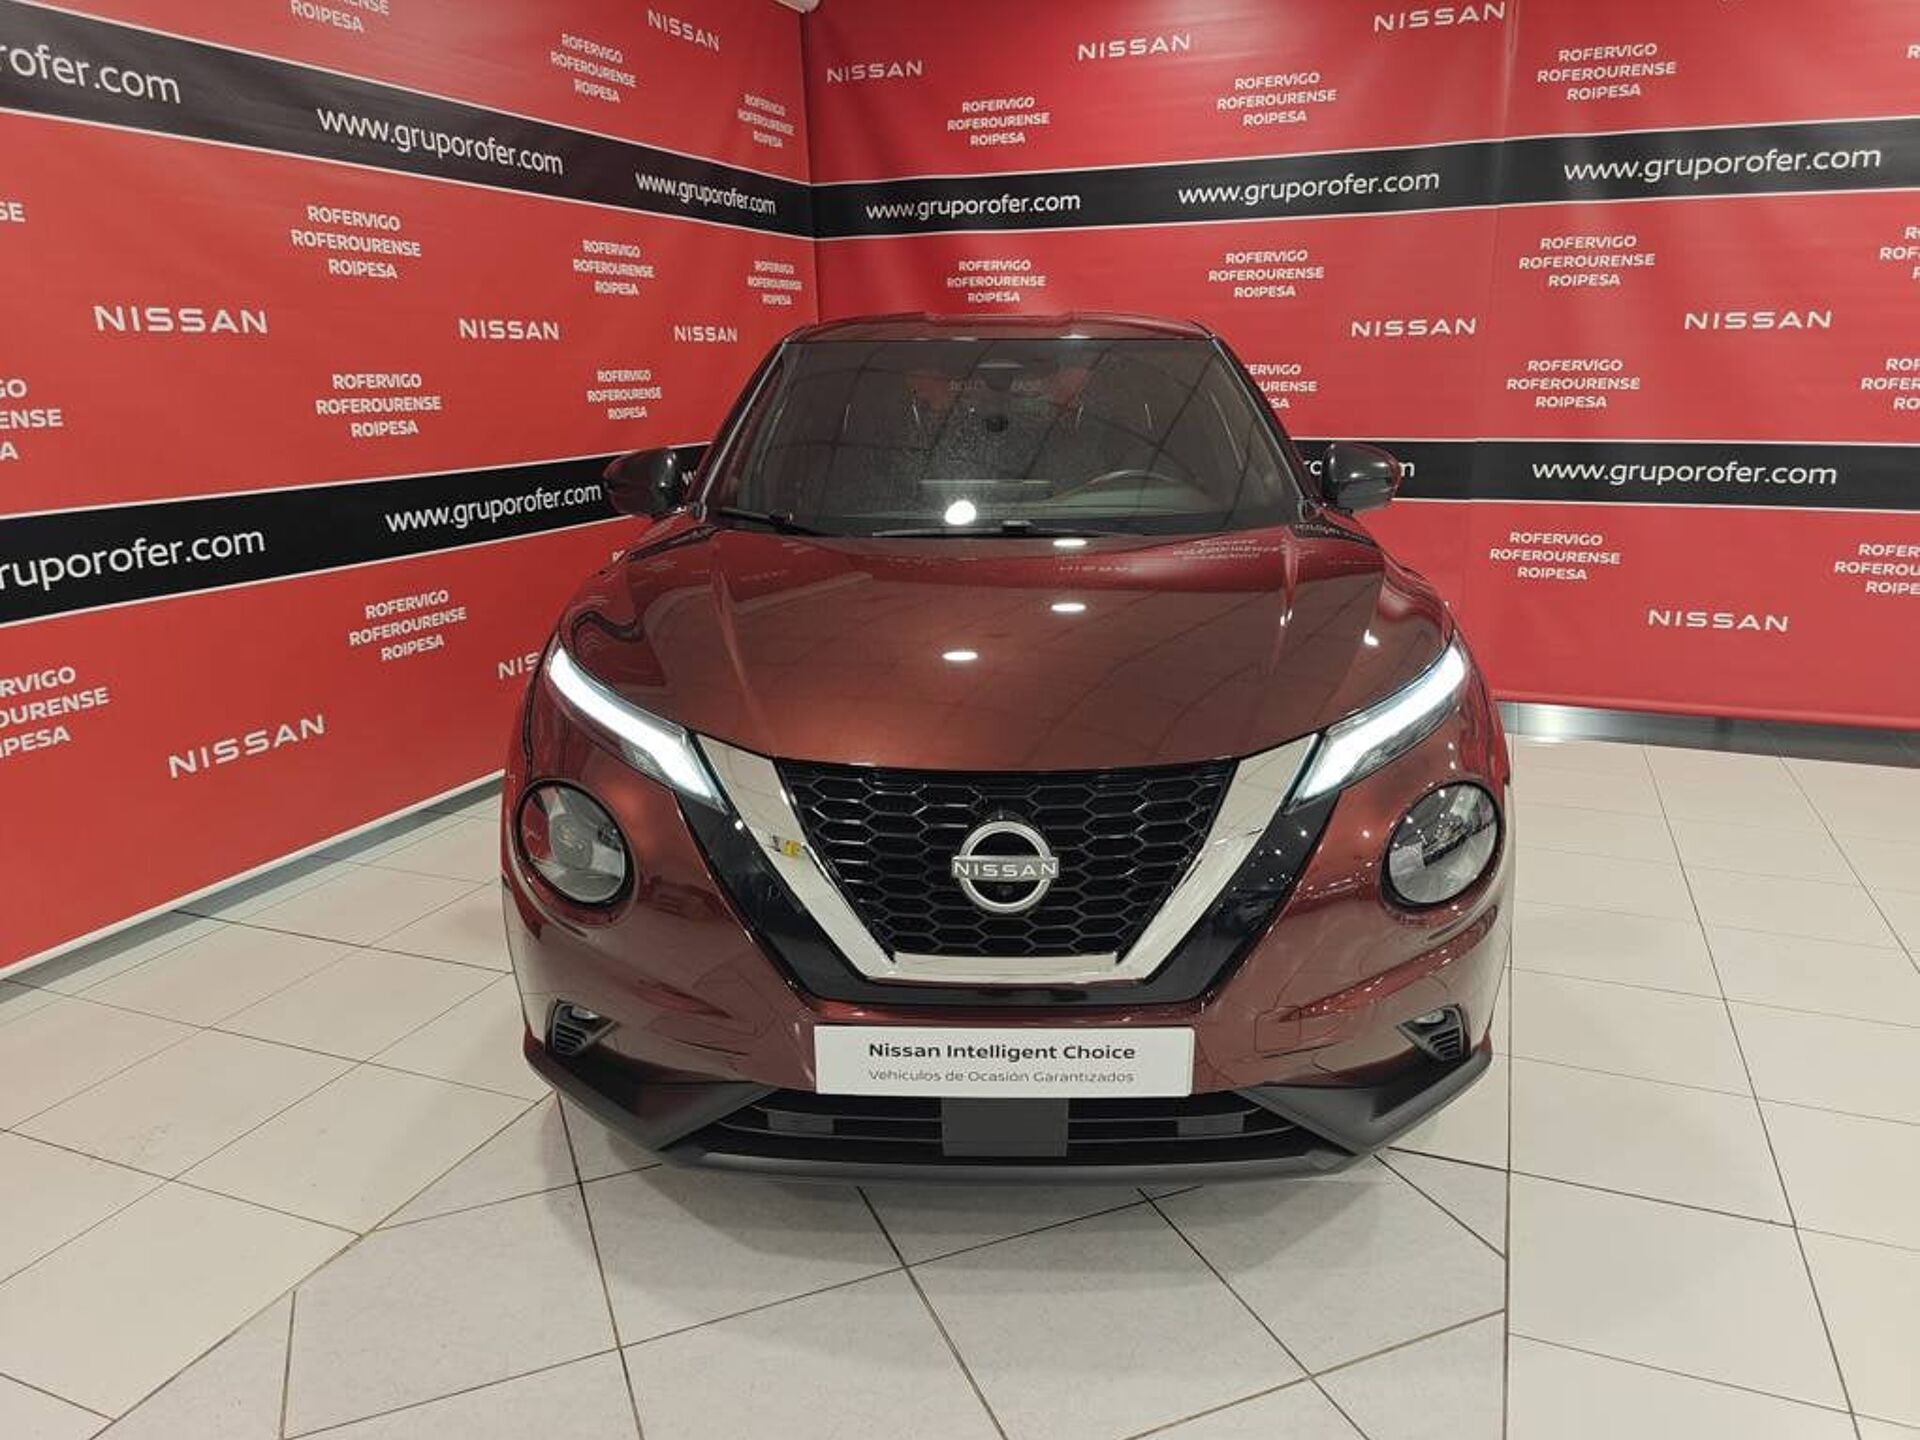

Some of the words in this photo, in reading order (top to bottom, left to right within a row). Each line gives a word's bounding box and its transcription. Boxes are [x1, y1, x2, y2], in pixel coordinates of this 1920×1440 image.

[1373, 3, 1505, 32] NISSAN
[647, 9, 720, 52] NISSAN
[562, 33, 623, 64] ROFERVIGO
[1077, 34, 1191, 61] NISSAN
[1558, 43, 1658, 63] ROFERVIGO
[0, 44, 181, 104] ofer.com
[551, 51, 636, 88] ROFEROURENSE
[827, 60, 922, 83] NISSAN
[1537, 62, 1677, 83] ROFEROURENSE
[1234, 72, 1320, 90] ROFERVIGO
[573, 79, 620, 103] ROIPESA
[1217, 89, 1337, 110] ROFEROURENSE
[1567, 84, 1642, 101] ROIPESA
[962, 97, 1035, 114] ROFERVIGO
[947, 112, 1050, 131] ROFEROURENSE
[1242, 110, 1307, 127] ROIPESA
[317, 108, 563, 175] www.gruporofer.com
[970, 132, 1025, 146] ROIPESA
[1564, 148, 1881, 183] www.gruporofer.com
[635, 171, 776, 215] www.gruporofer.com
[1178, 172, 1440, 206] www.gruporofer.com
[866, 191, 1081, 221] www.gruporofer.com
[307, 205, 401, 231] ROFERVIGO
[291, 229, 422, 257] ROFEROURENSE
[583, 240, 641, 259] ROFERVIGO
[1540, 235, 1637, 250] ROFERVIGO
[958, 258, 1032, 272] ROFERVIGO
[1225, 249, 1308, 265] ROFERVIGO
[1519, 253, 1655, 270] ROFEROURENSE
[328, 258, 398, 279] ROIPESA
[1208, 266, 1324, 282] ROFEROURENSE
[947, 275, 1046, 289] ROFEROURENSE
[1548, 273, 1621, 288] ROIPESA
[967, 290, 1021, 303] ROIPESA
[1233, 285, 1297, 299] ROIPESA
[94, 305, 267, 334] NISSAN
[1351, 318, 1477, 337] NISSAN
[1683, 310, 1832, 331] NISSAN
[459, 319, 560, 342] NISSAN
[674, 325, 738, 343] NISSAN
[1244, 363, 1302, 375] ERVIGO
[1527, 359, 1623, 372] ROFERVIGO
[333, 373, 422, 390] ROFERVIGO
[1257, 381, 1318, 392] URENSE
[1506, 377, 1640, 390] ROFEROURENSE
[316, 396, 442, 415] ROFEROURENSE
[1535, 395, 1607, 408] ROIPESA
[351, 420, 418, 438] ROIPESA
[1532, 461, 1837, 486] www.gruporofer.com
[385, 483, 602, 534] www.gruporofer.com
[1509, 532, 1603, 546] ROFERVIGO
[1490, 548, 1621, 565] ROFEROURENSE
[1517, 566, 1588, 580] ROIPESA
[365, 589, 449, 618] ROFERVIGO
[349, 607, 467, 646] ROFEROURENSE
[1648, 609, 1789, 633] NISSAN
[381, 635, 444, 662] ROIPESA
[497, 652, 540, 681] NIS
[168, 714, 326, 778] NISSAN
[953, 861, 1057, 877] NISSAN
[869, 1043, 941, 1058] Nissan
[947, 1043, 1058, 1062] Intelligent
[1063, 1045, 1136, 1060] Choice
[946, 1069, 965, 1082] de
[1033, 1070, 1135, 1083] Garantizados
